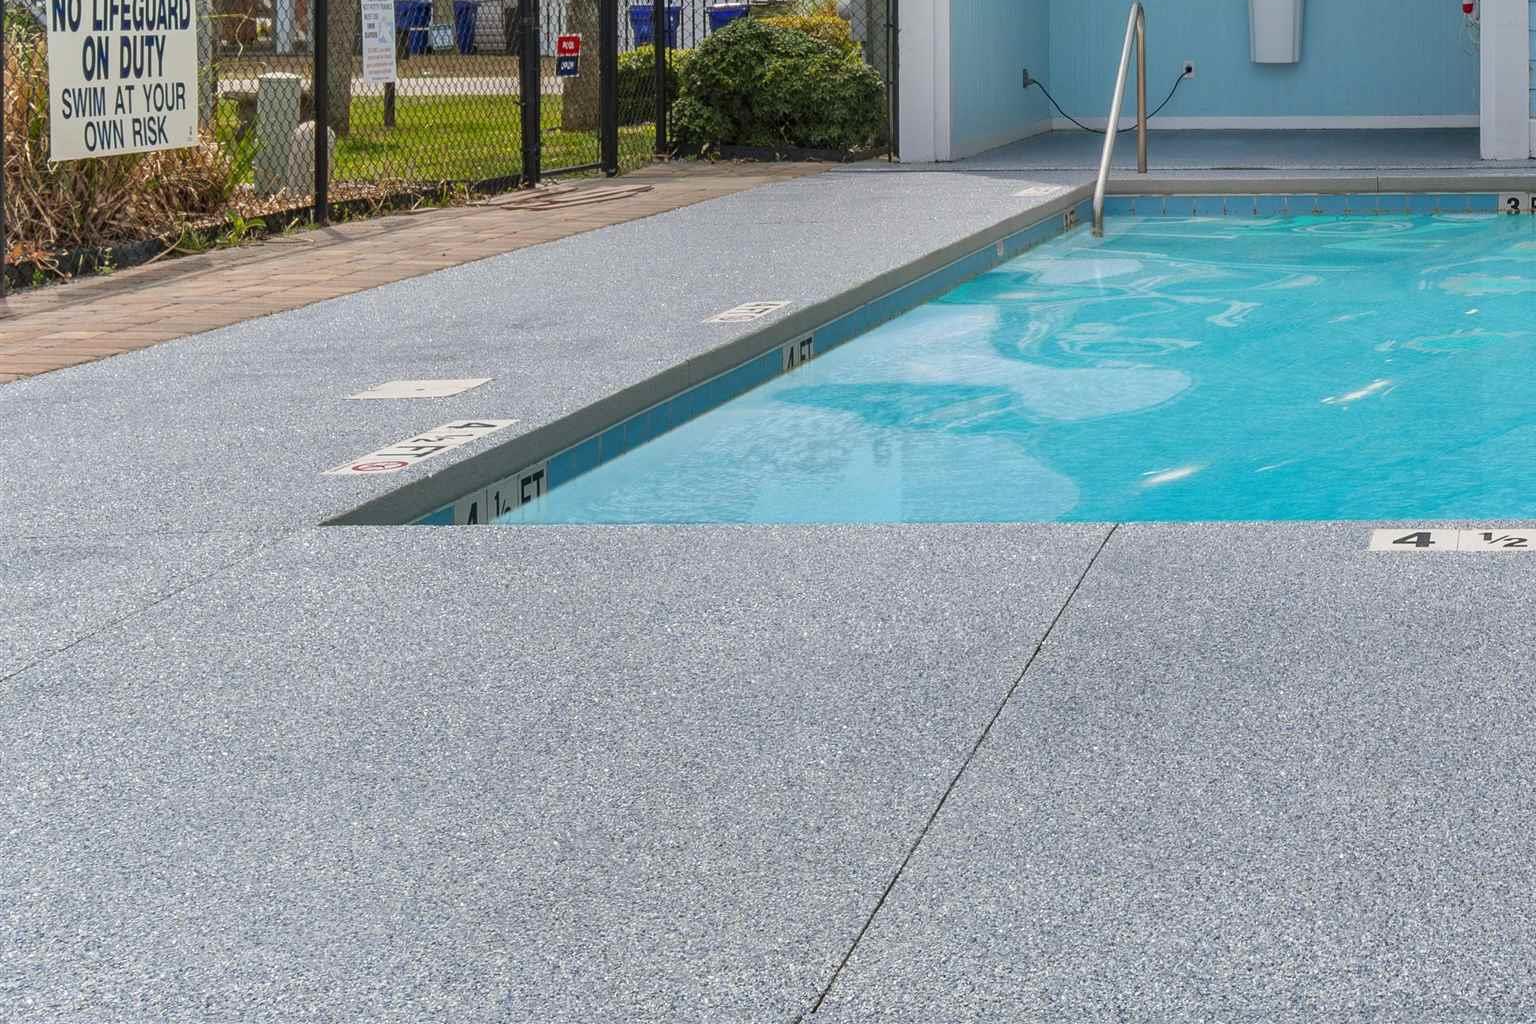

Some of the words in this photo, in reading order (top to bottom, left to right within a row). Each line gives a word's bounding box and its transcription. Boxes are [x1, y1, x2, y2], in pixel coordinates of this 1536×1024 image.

[82, 35, 109, 81] ON
[120, 35, 166, 79] DUTY
[62, 86, 106, 119] SWIM
[114, 85, 135, 115] AT
[143, 82, 186, 113] YOUR
[84, 119, 124, 152] OWN
[133, 116, 168, 147] RISK
[1506, 197, 1521, 215] 3
[521, 469, 545, 504] FT
[1392, 531, 1435, 548] 4
